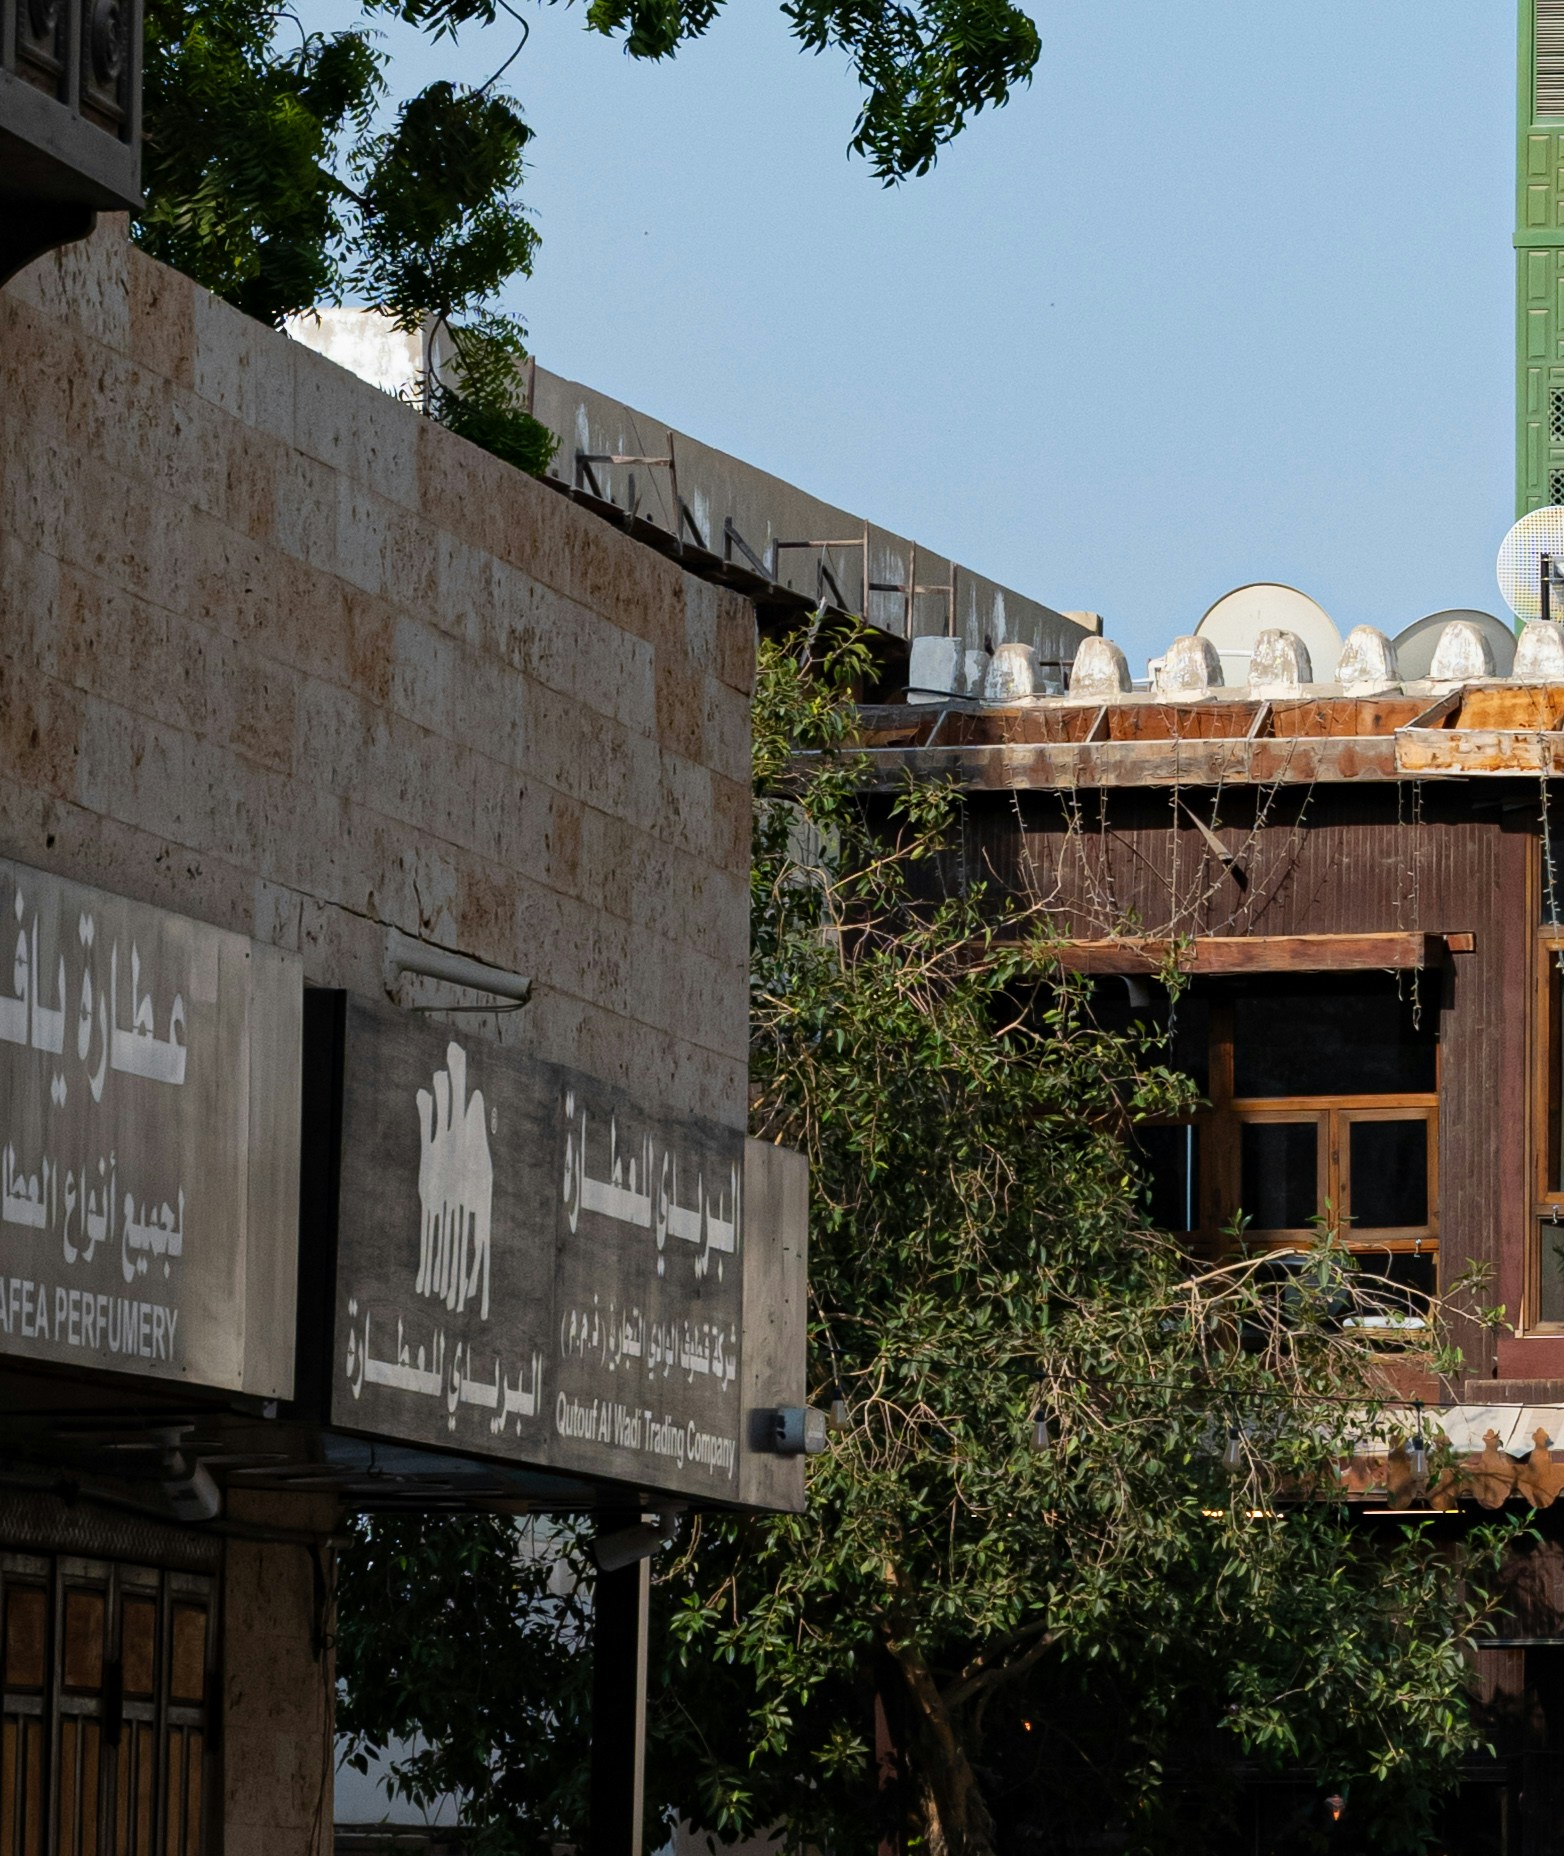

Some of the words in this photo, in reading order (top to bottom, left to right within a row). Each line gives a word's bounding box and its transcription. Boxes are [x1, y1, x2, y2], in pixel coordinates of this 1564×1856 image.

[0, 886, 67, 1109] ياف
[77, 911, 187, 1104] عطارة
[63, 1149, 116, 1265] أنواع
[563, 1090, 655, 1235] للعطارة
[121, 1183, 185, 1284] لجميع
[656, 1150, 742, 1285] البريدي
[54, 1286, 179, 1362] PERFUMERY
[346, 1297, 446, 1401] للعطارة
[648, 1320, 679, 1380] الوادي
[680, 1319, 710, 1384] قطوف
[711, 1323, 737, 1392] شركة
[447, 1341, 543, 1437] البريدي
[556, 1390, 598, 1439] Qutouf
[598, 1401, 612, 1443] Al
[613, 1402, 641, 1449] Wadi
[644, 1410, 685, 1470] Trading
[686, 1419, 736, 1480] Company
